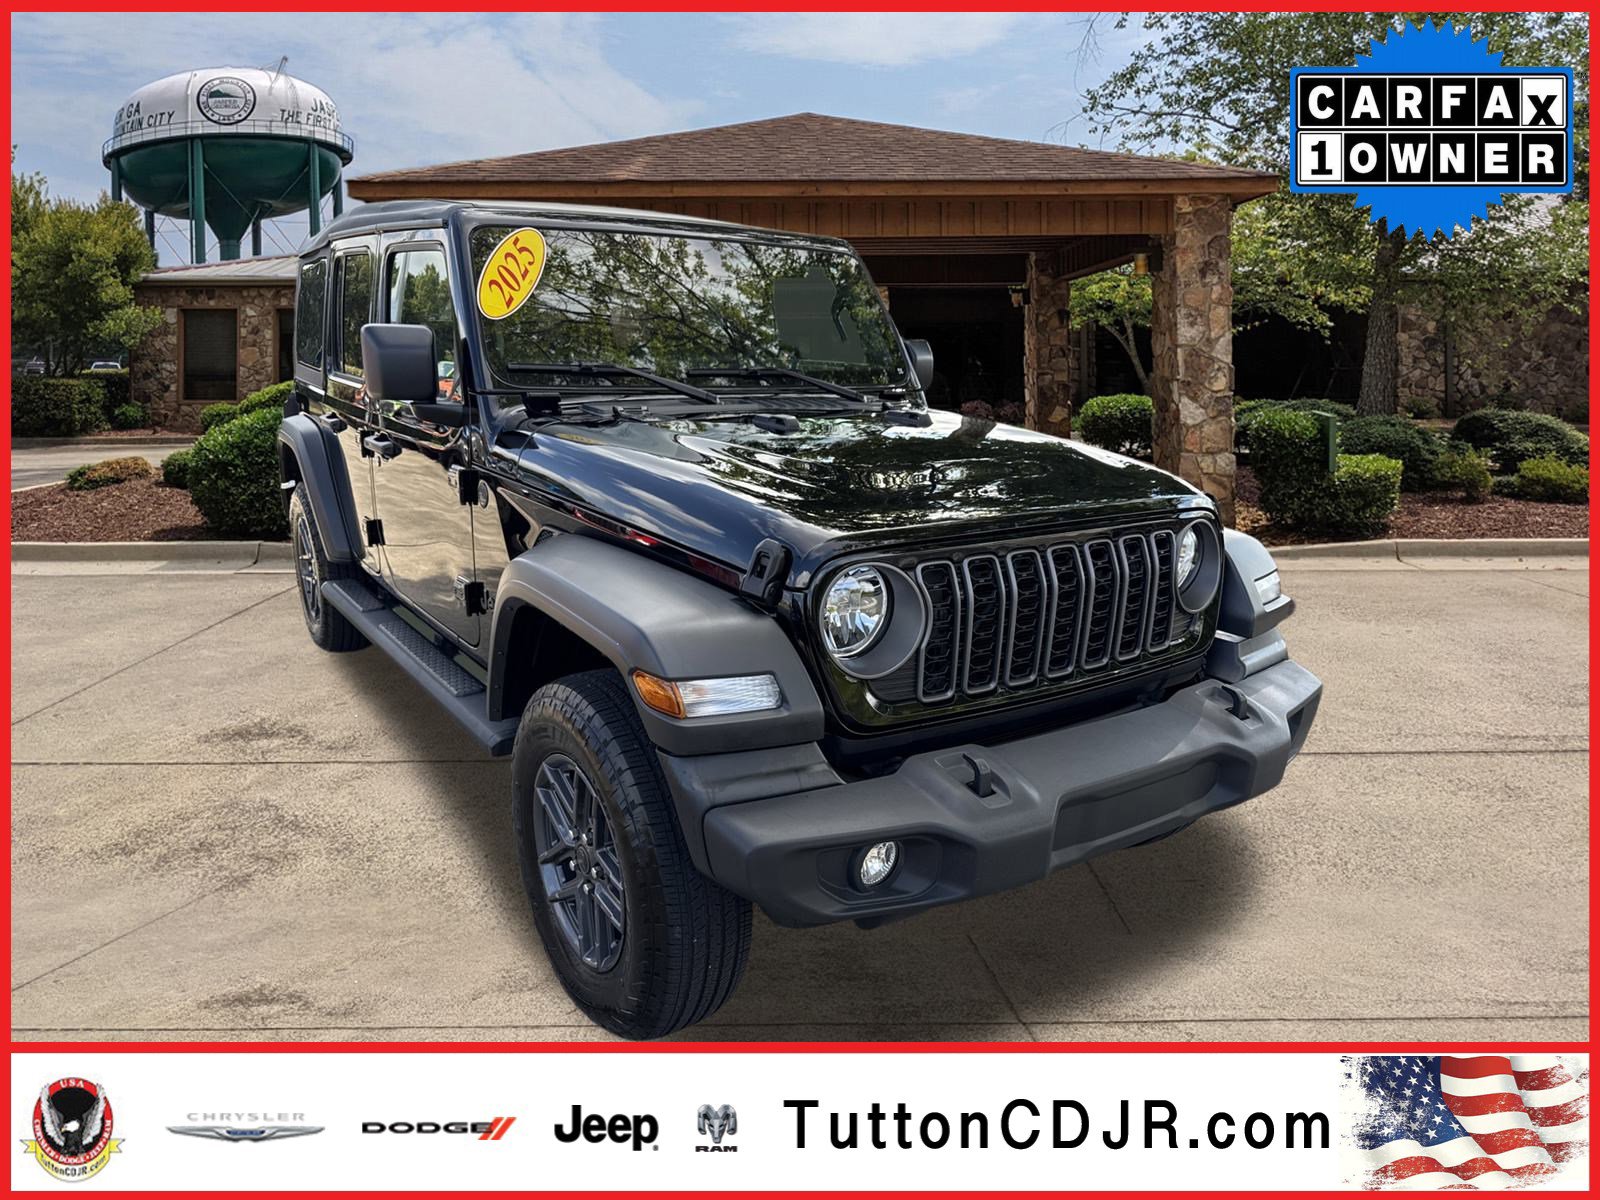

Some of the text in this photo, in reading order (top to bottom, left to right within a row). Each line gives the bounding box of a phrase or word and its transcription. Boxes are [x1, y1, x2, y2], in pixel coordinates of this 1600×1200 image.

[126, 101, 140, 119] GA
[147, 110, 175, 127] CITY
[280, 108, 302, 124] THE
[488, 236, 536, 309] 2025
